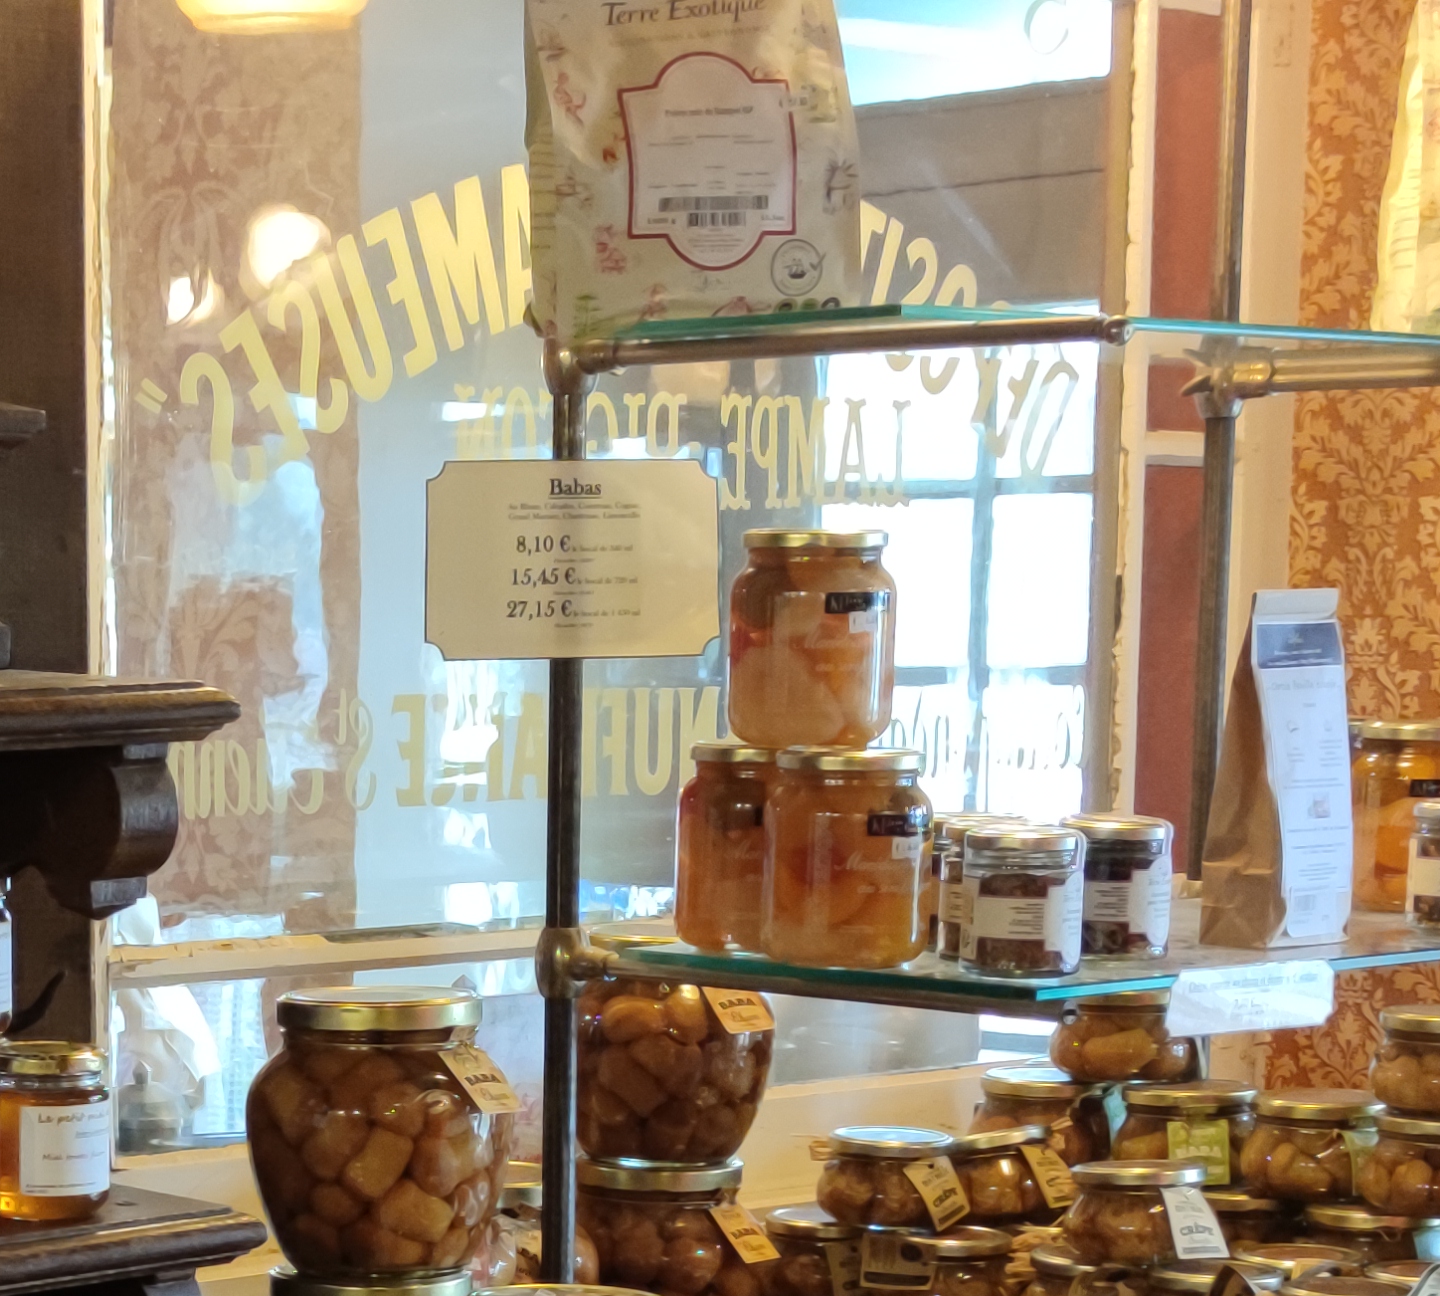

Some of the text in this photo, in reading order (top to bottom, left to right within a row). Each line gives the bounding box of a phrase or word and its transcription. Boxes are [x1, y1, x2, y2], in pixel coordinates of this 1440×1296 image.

[603, 2, 659, 26] Terre
[549, 478, 602, 497] Babas
[516, 535, 554, 556] 8,10
[560, 535, 571, 553] €
[511, 567, 559, 588] 15,45
[564, 567, 576, 586] €
[506, 600, 573, 620] 27,15 €
[38, 1111, 85, 1126] Le petit
